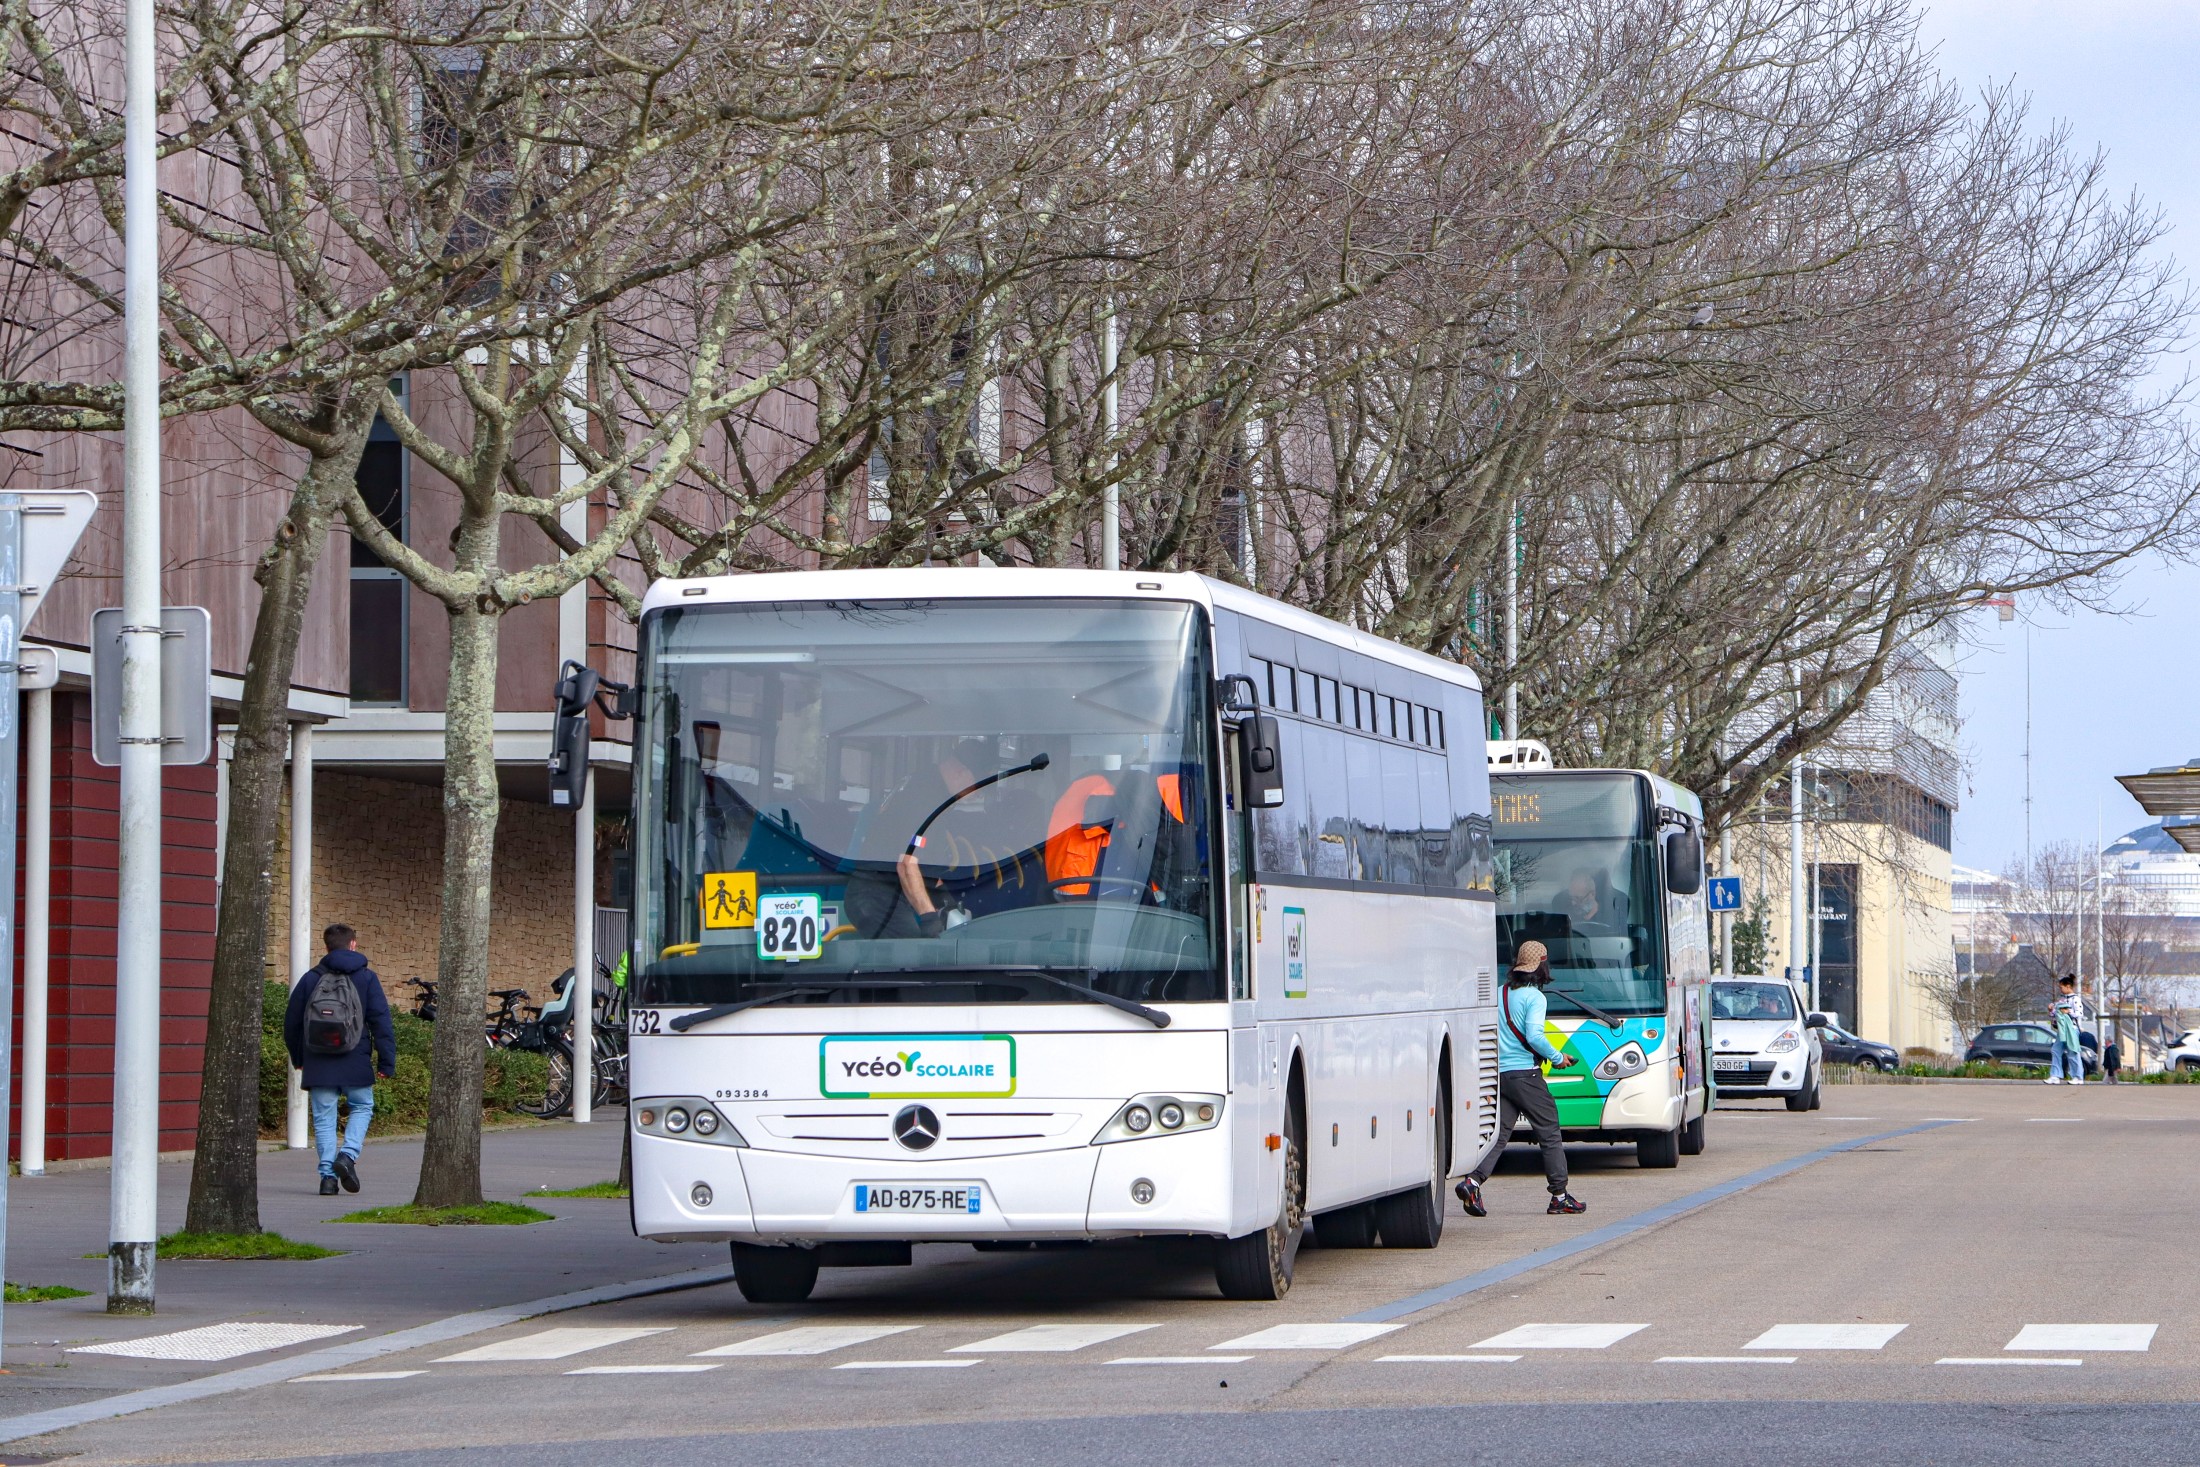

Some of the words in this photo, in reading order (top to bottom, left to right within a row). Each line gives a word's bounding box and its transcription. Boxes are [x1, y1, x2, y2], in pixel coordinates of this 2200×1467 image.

[763, 916, 815, 952] 820
[631, 1009, 661, 1034] 732
[916, 1064, 994, 1077] SCOLAIRE
[716, 1090, 769, 1098] 093384
[868, 1189, 967, 1209] AD-875-RE
[969, 1201, 979, 1211] 44
